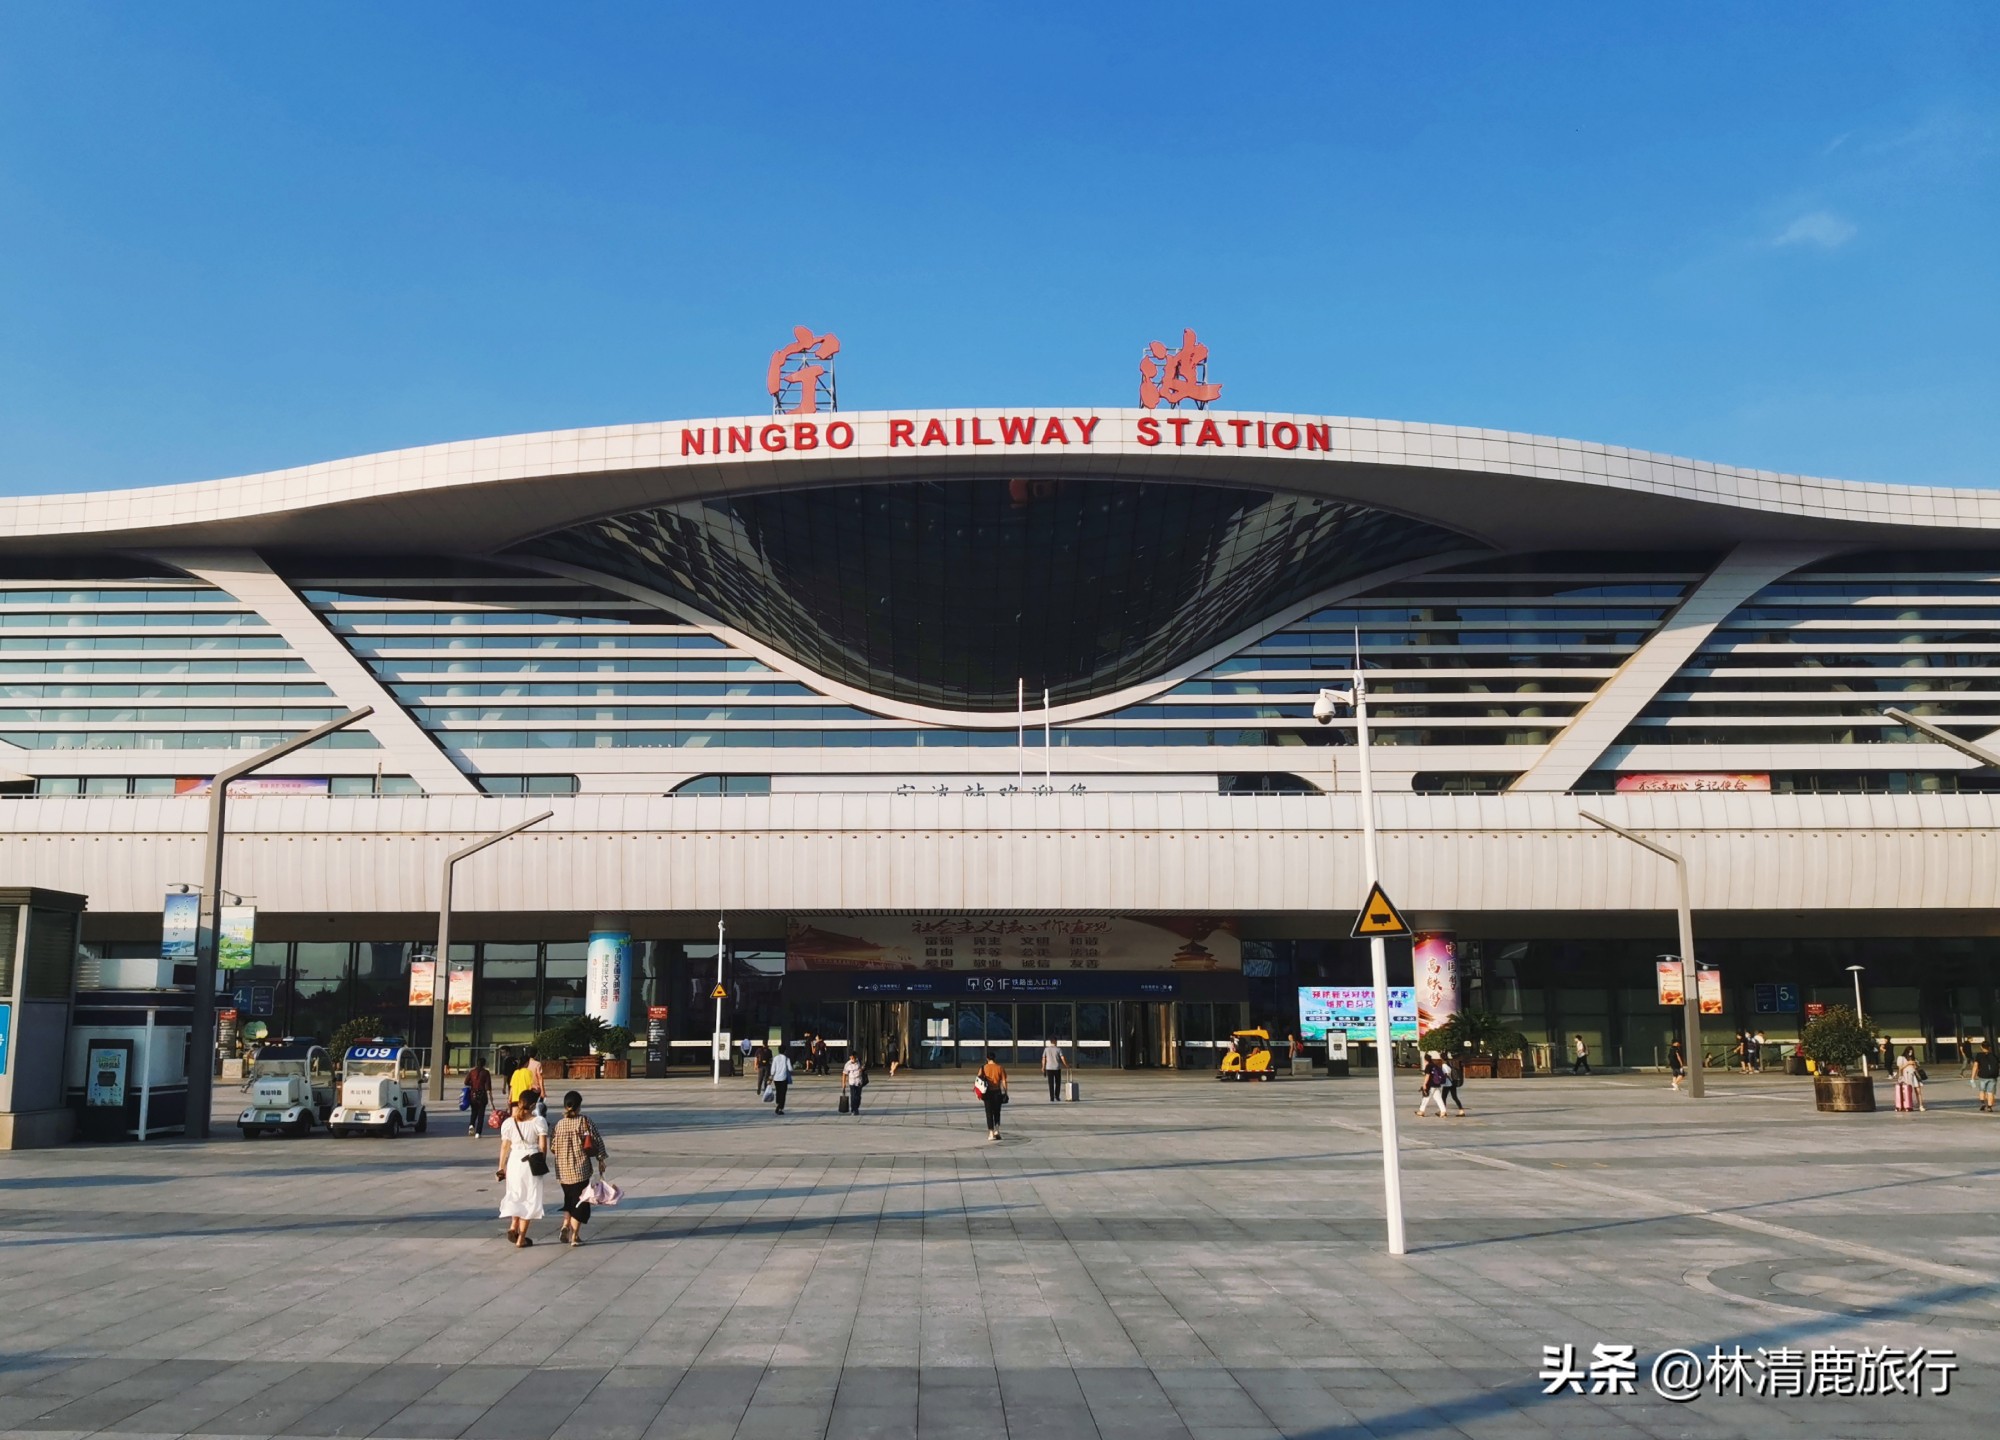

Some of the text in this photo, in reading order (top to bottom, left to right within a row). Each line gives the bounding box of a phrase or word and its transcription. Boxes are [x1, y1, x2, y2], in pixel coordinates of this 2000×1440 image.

[680, 415, 1332, 457] NINGBO RAILWAY STATION
[911, 918, 1112, 935] 社会主义核心价值观
[973, 936, 1001, 946] 民主
[1020, 936, 1050, 946] 文明
[925, 948, 953, 957] 自由
[354, 1047, 392, 1058] 009
